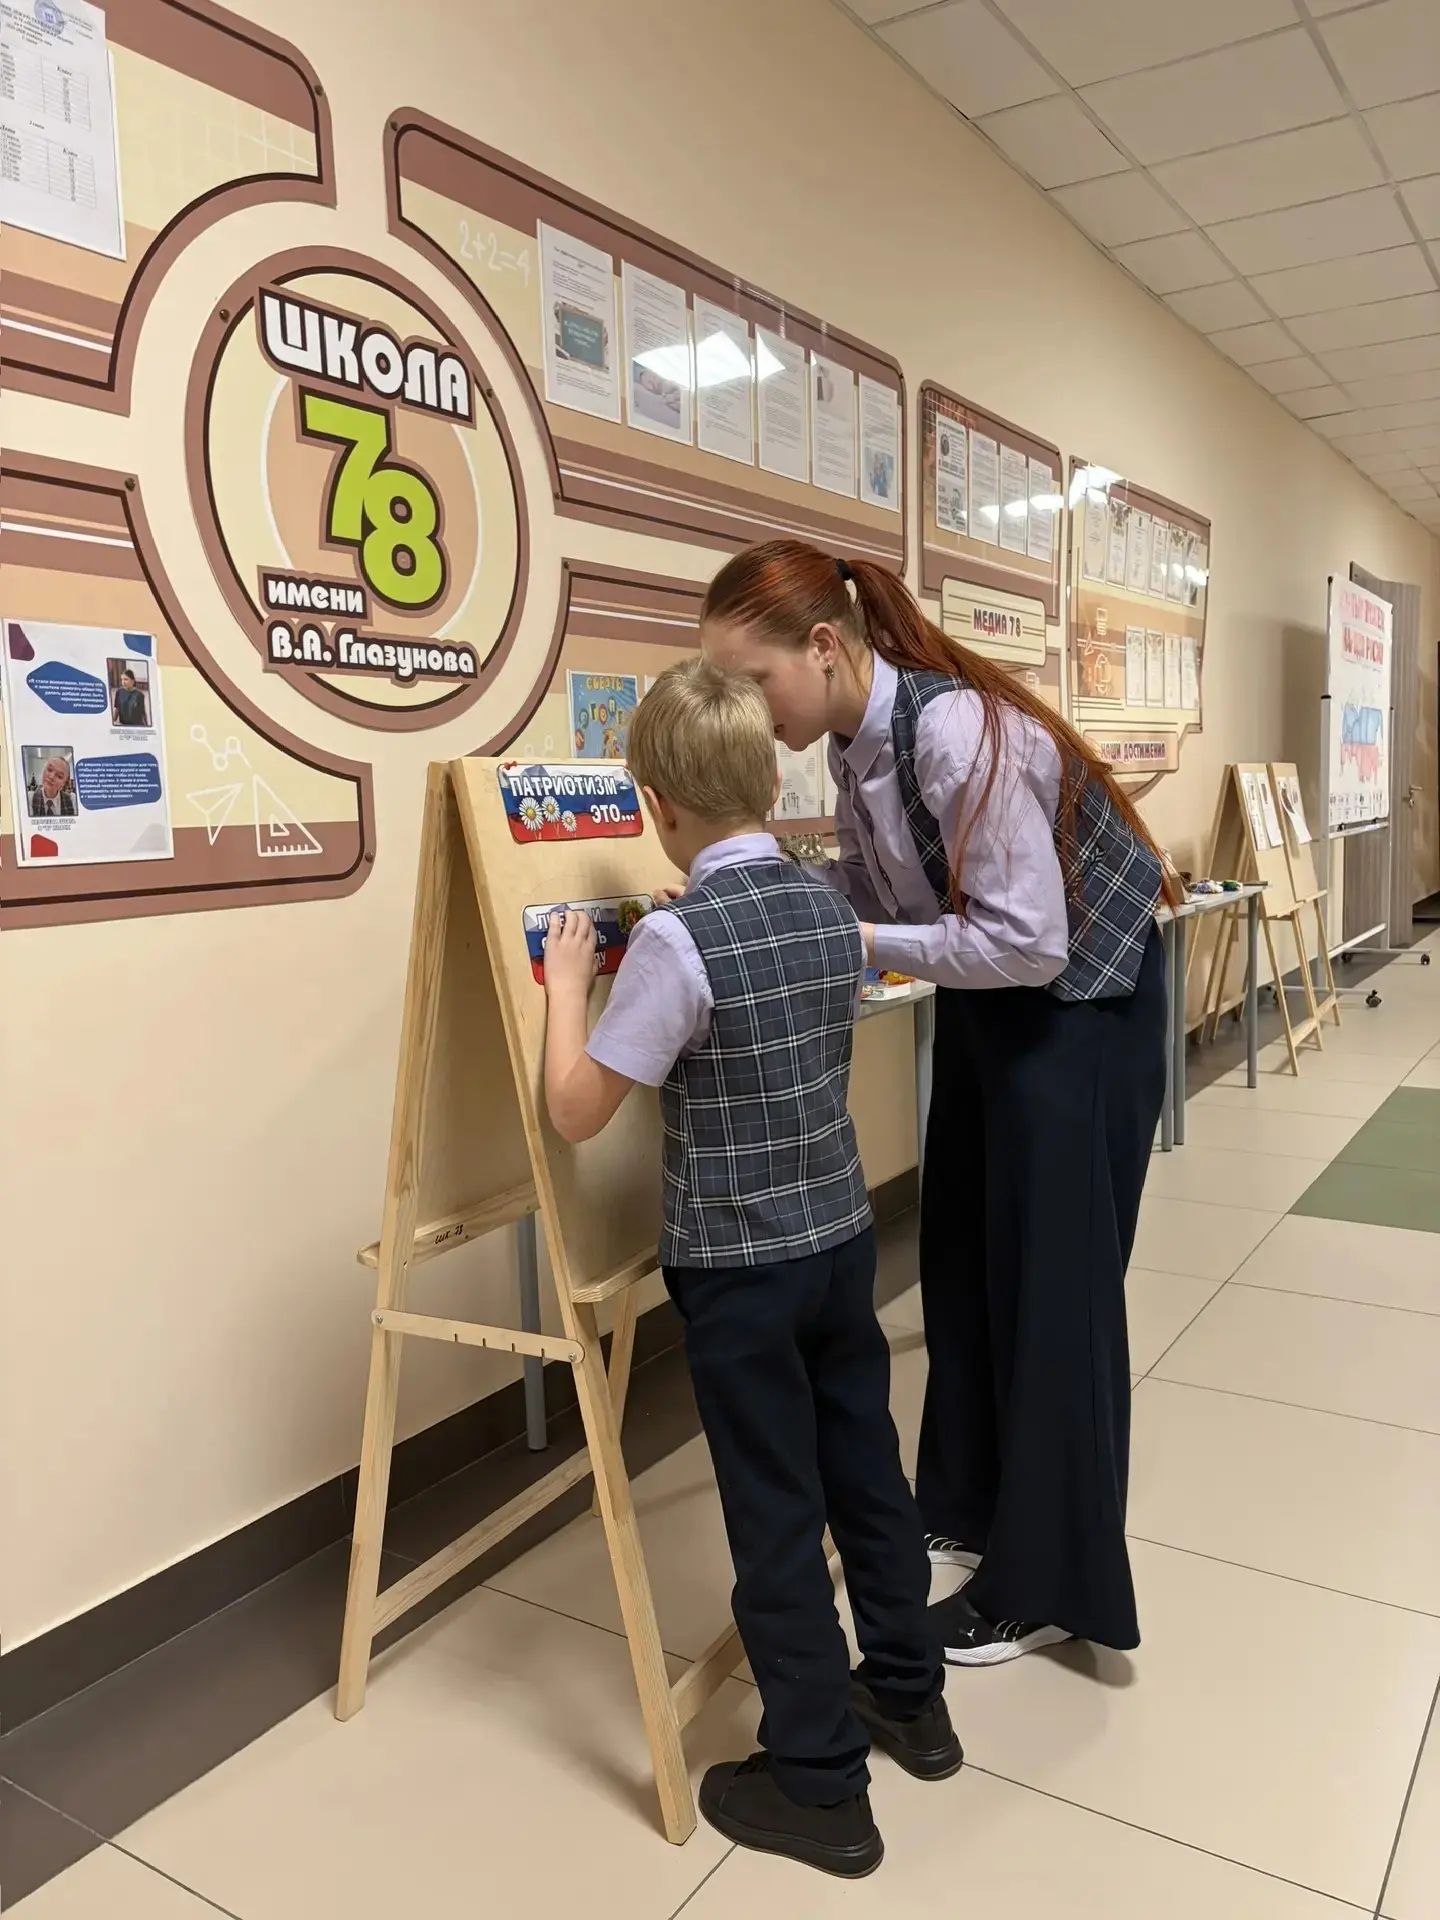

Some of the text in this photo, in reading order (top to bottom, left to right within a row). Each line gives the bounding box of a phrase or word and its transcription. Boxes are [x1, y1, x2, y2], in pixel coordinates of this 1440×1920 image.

[263, 294, 469, 417] ШКОЛА
[304, 394, 442, 604] 78
[267, 579, 364, 613] имени
[973, 608, 1021, 637] МЕДИА 78
[271, 626, 475, 676] В.А. Глазунова
[510, 774, 617, 797] ПАТРИОТИЗМ
[590, 803, 636, 824] ЭТО...
